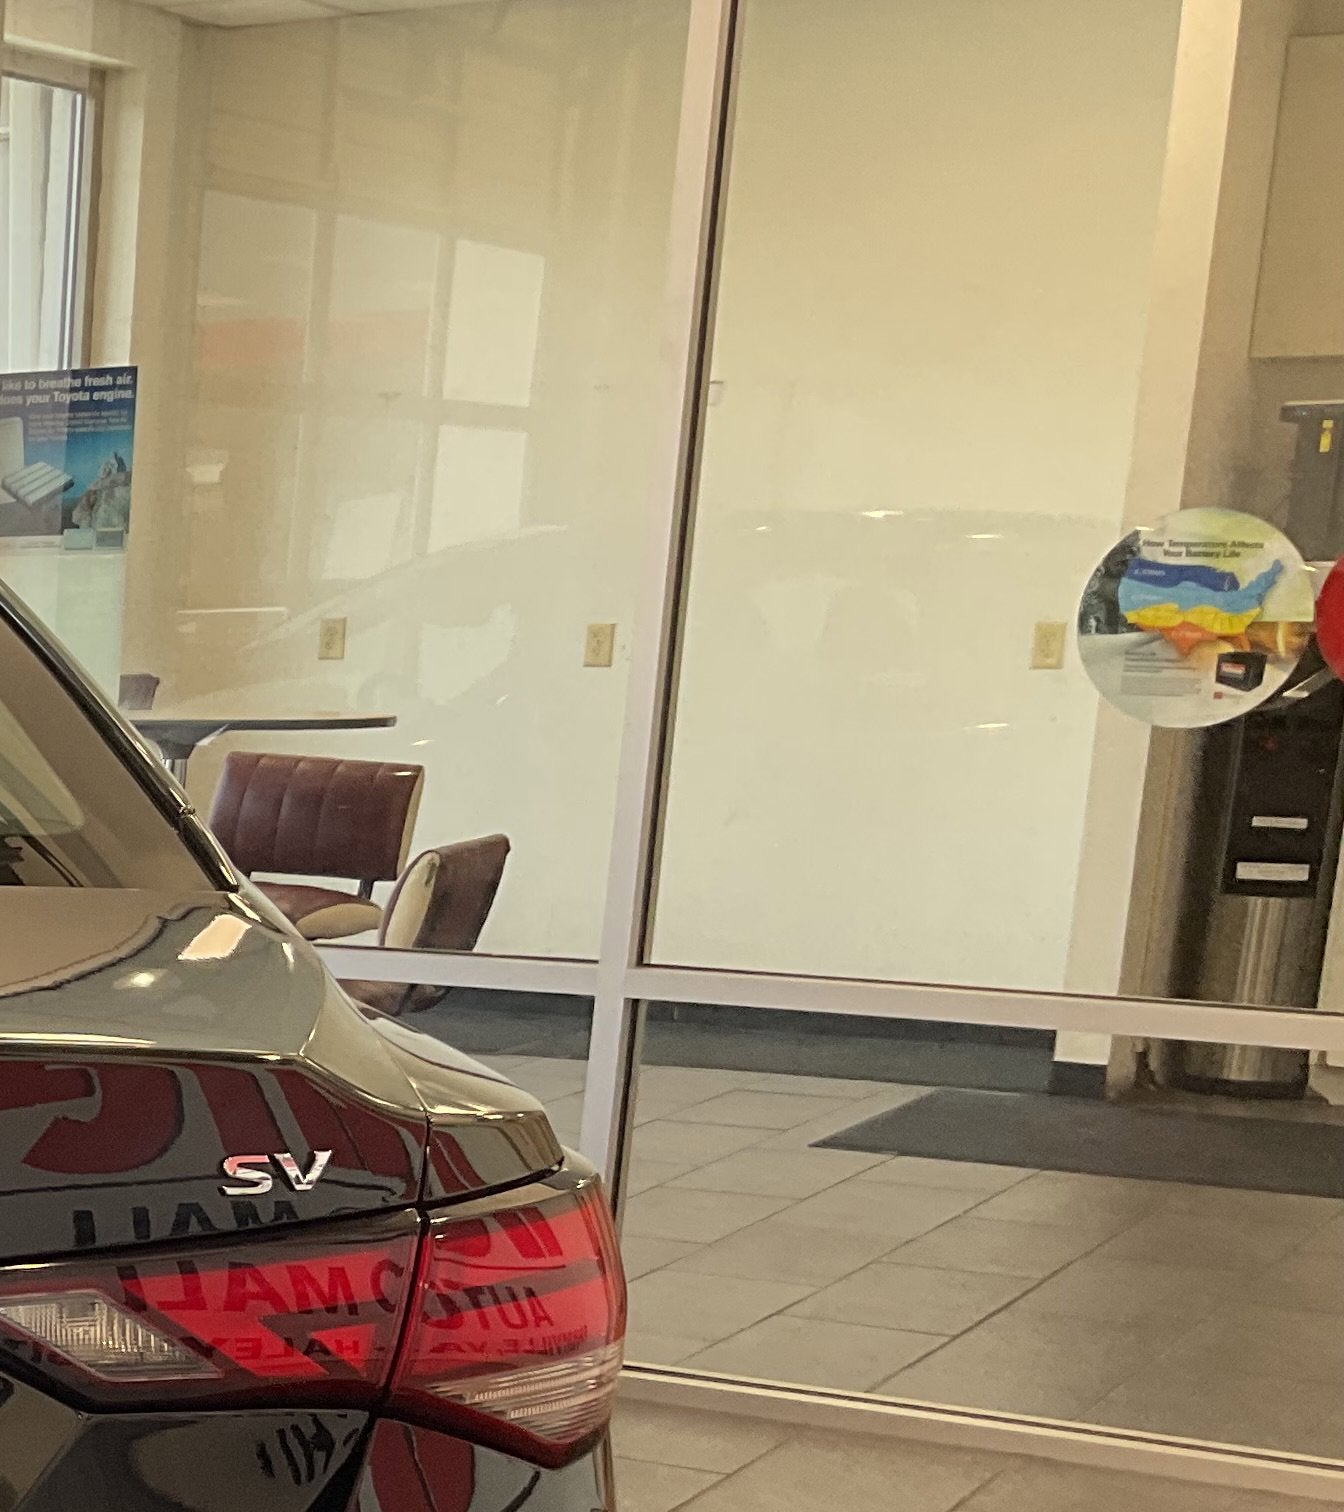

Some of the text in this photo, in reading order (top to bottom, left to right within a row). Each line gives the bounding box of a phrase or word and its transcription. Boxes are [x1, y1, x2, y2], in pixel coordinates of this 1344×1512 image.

[2, 380, 22, 391] like
[24, 379, 36, 391] to
[38, 376, 82, 390] breathe
[84, 374, 113, 388] fresh
[26, 394, 51, 407] your
[53, 390, 91, 404] Toyota
[93, 388, 135, 402] engine.
[1141, 539, 1165, 548] How
[1163, 550, 1241, 559] Your Battery Life
[220, 1149, 332, 1196] SV
